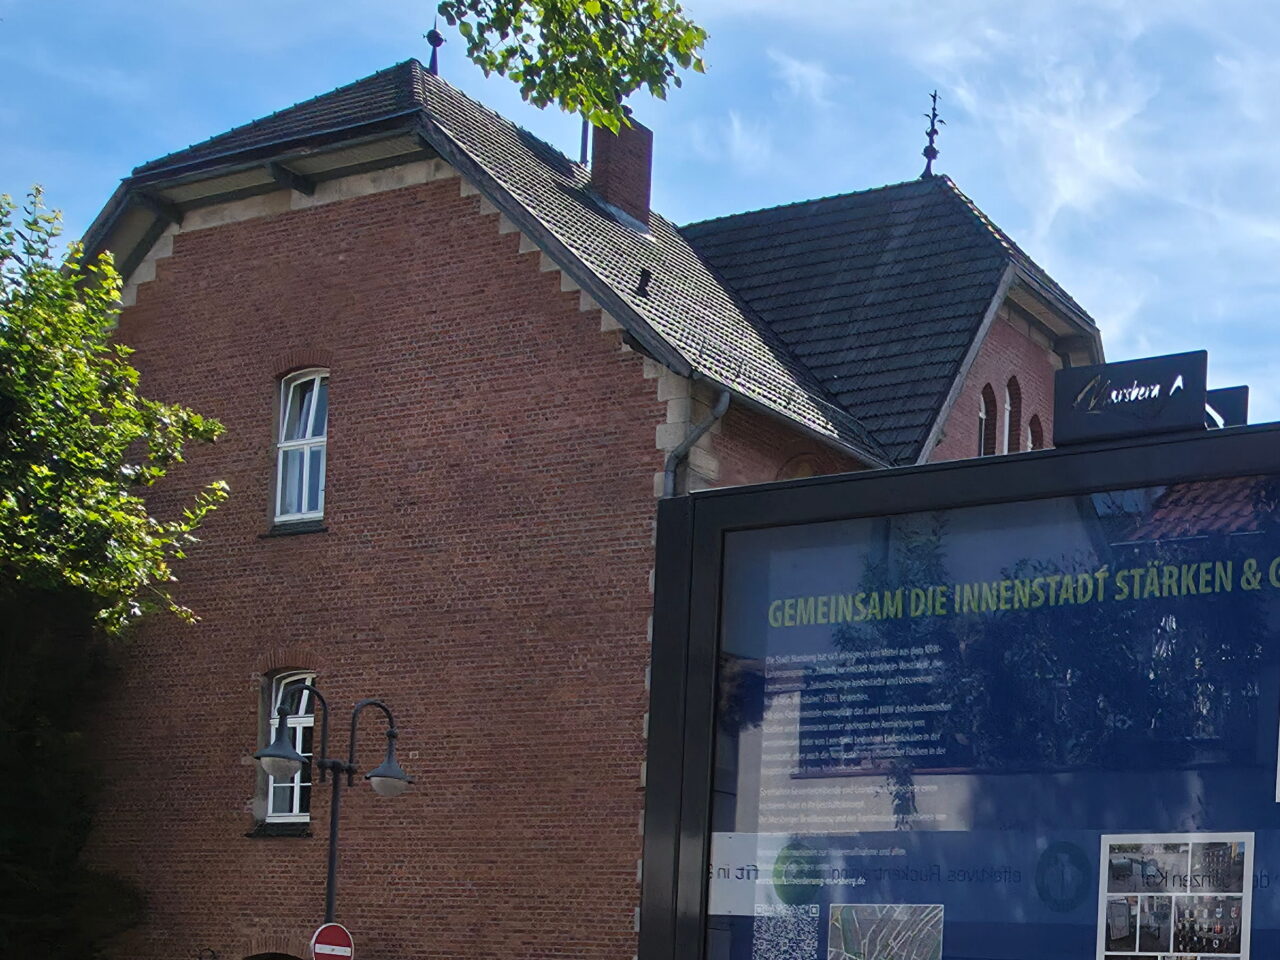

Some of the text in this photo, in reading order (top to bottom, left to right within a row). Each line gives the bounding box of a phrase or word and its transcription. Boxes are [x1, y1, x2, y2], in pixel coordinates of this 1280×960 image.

[768, 589, 903, 628] GEMEINSAM
[910, 585, 947, 617] DIE
[954, 571, 1109, 614] INNENSTADT
[1115, 560, 1233, 601] STÄRKEN
[1240, 558, 1262, 592] &
